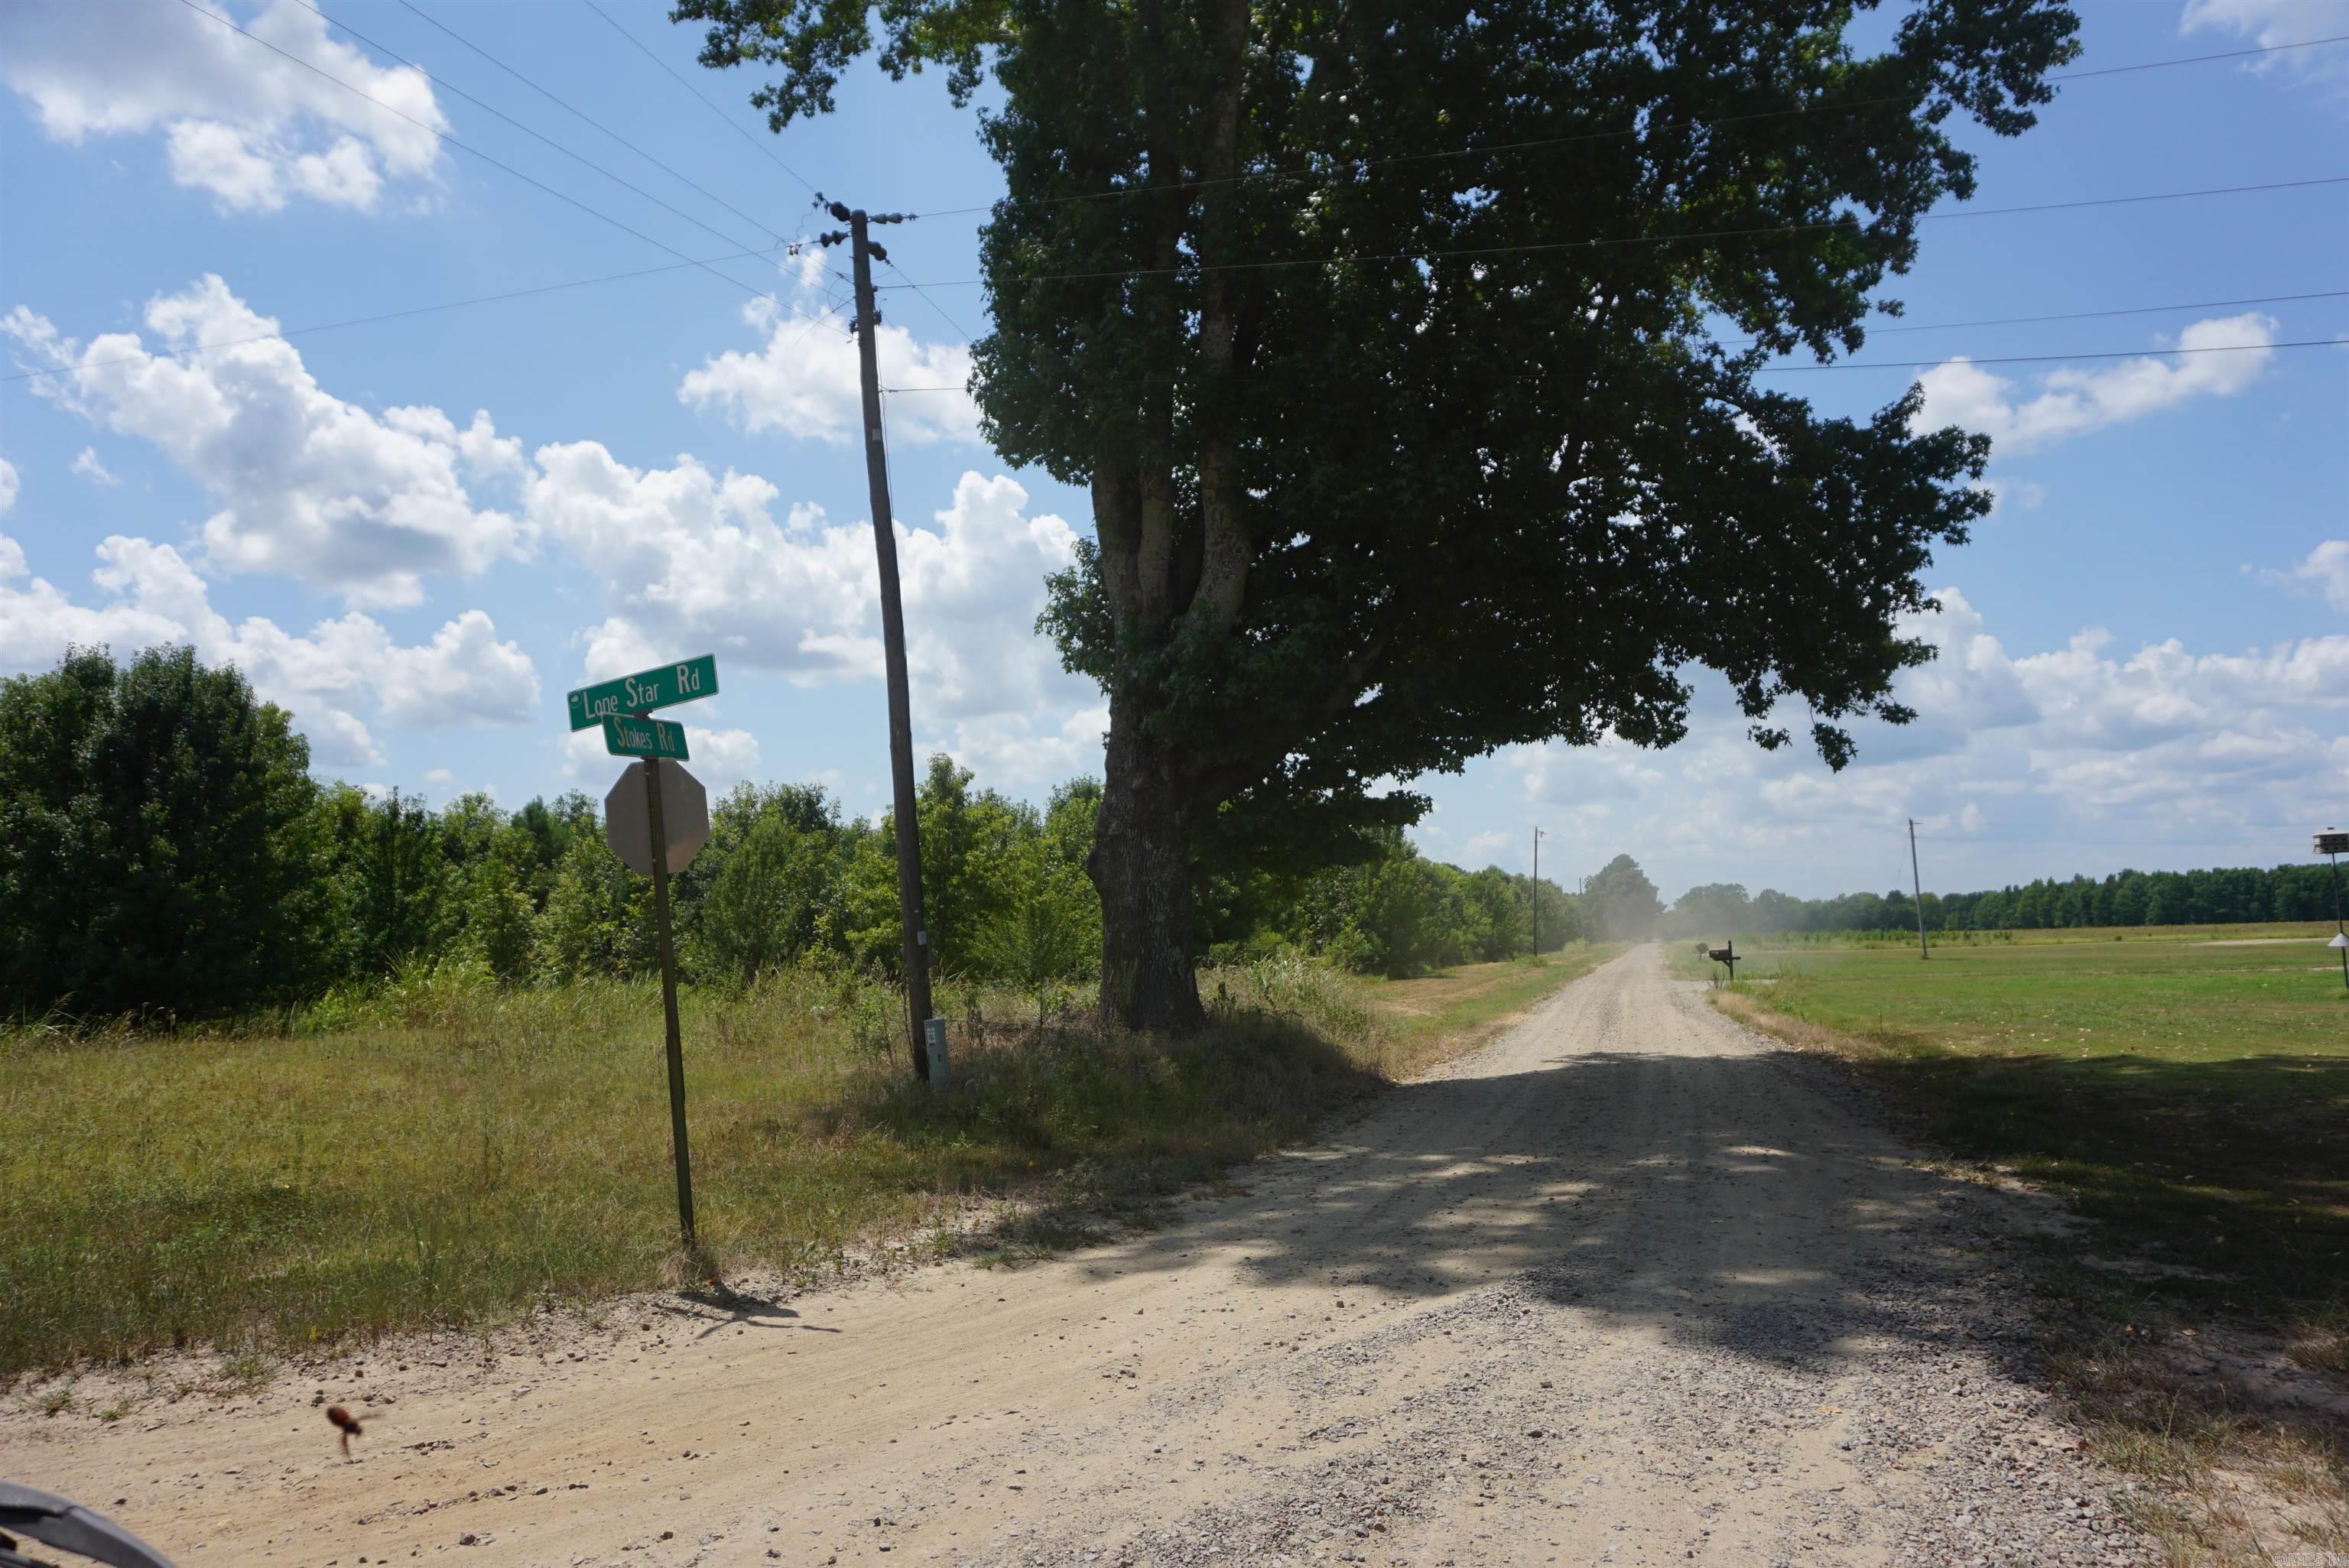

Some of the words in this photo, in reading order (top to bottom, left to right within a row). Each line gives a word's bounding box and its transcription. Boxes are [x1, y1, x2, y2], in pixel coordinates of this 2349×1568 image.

[583, 691, 618, 719] Lone
[625, 677, 659, 707] Star
[676, 664, 700, 694] Rd
[613, 717, 652, 750] Stokes
[656, 722, 674, 752] Rd
